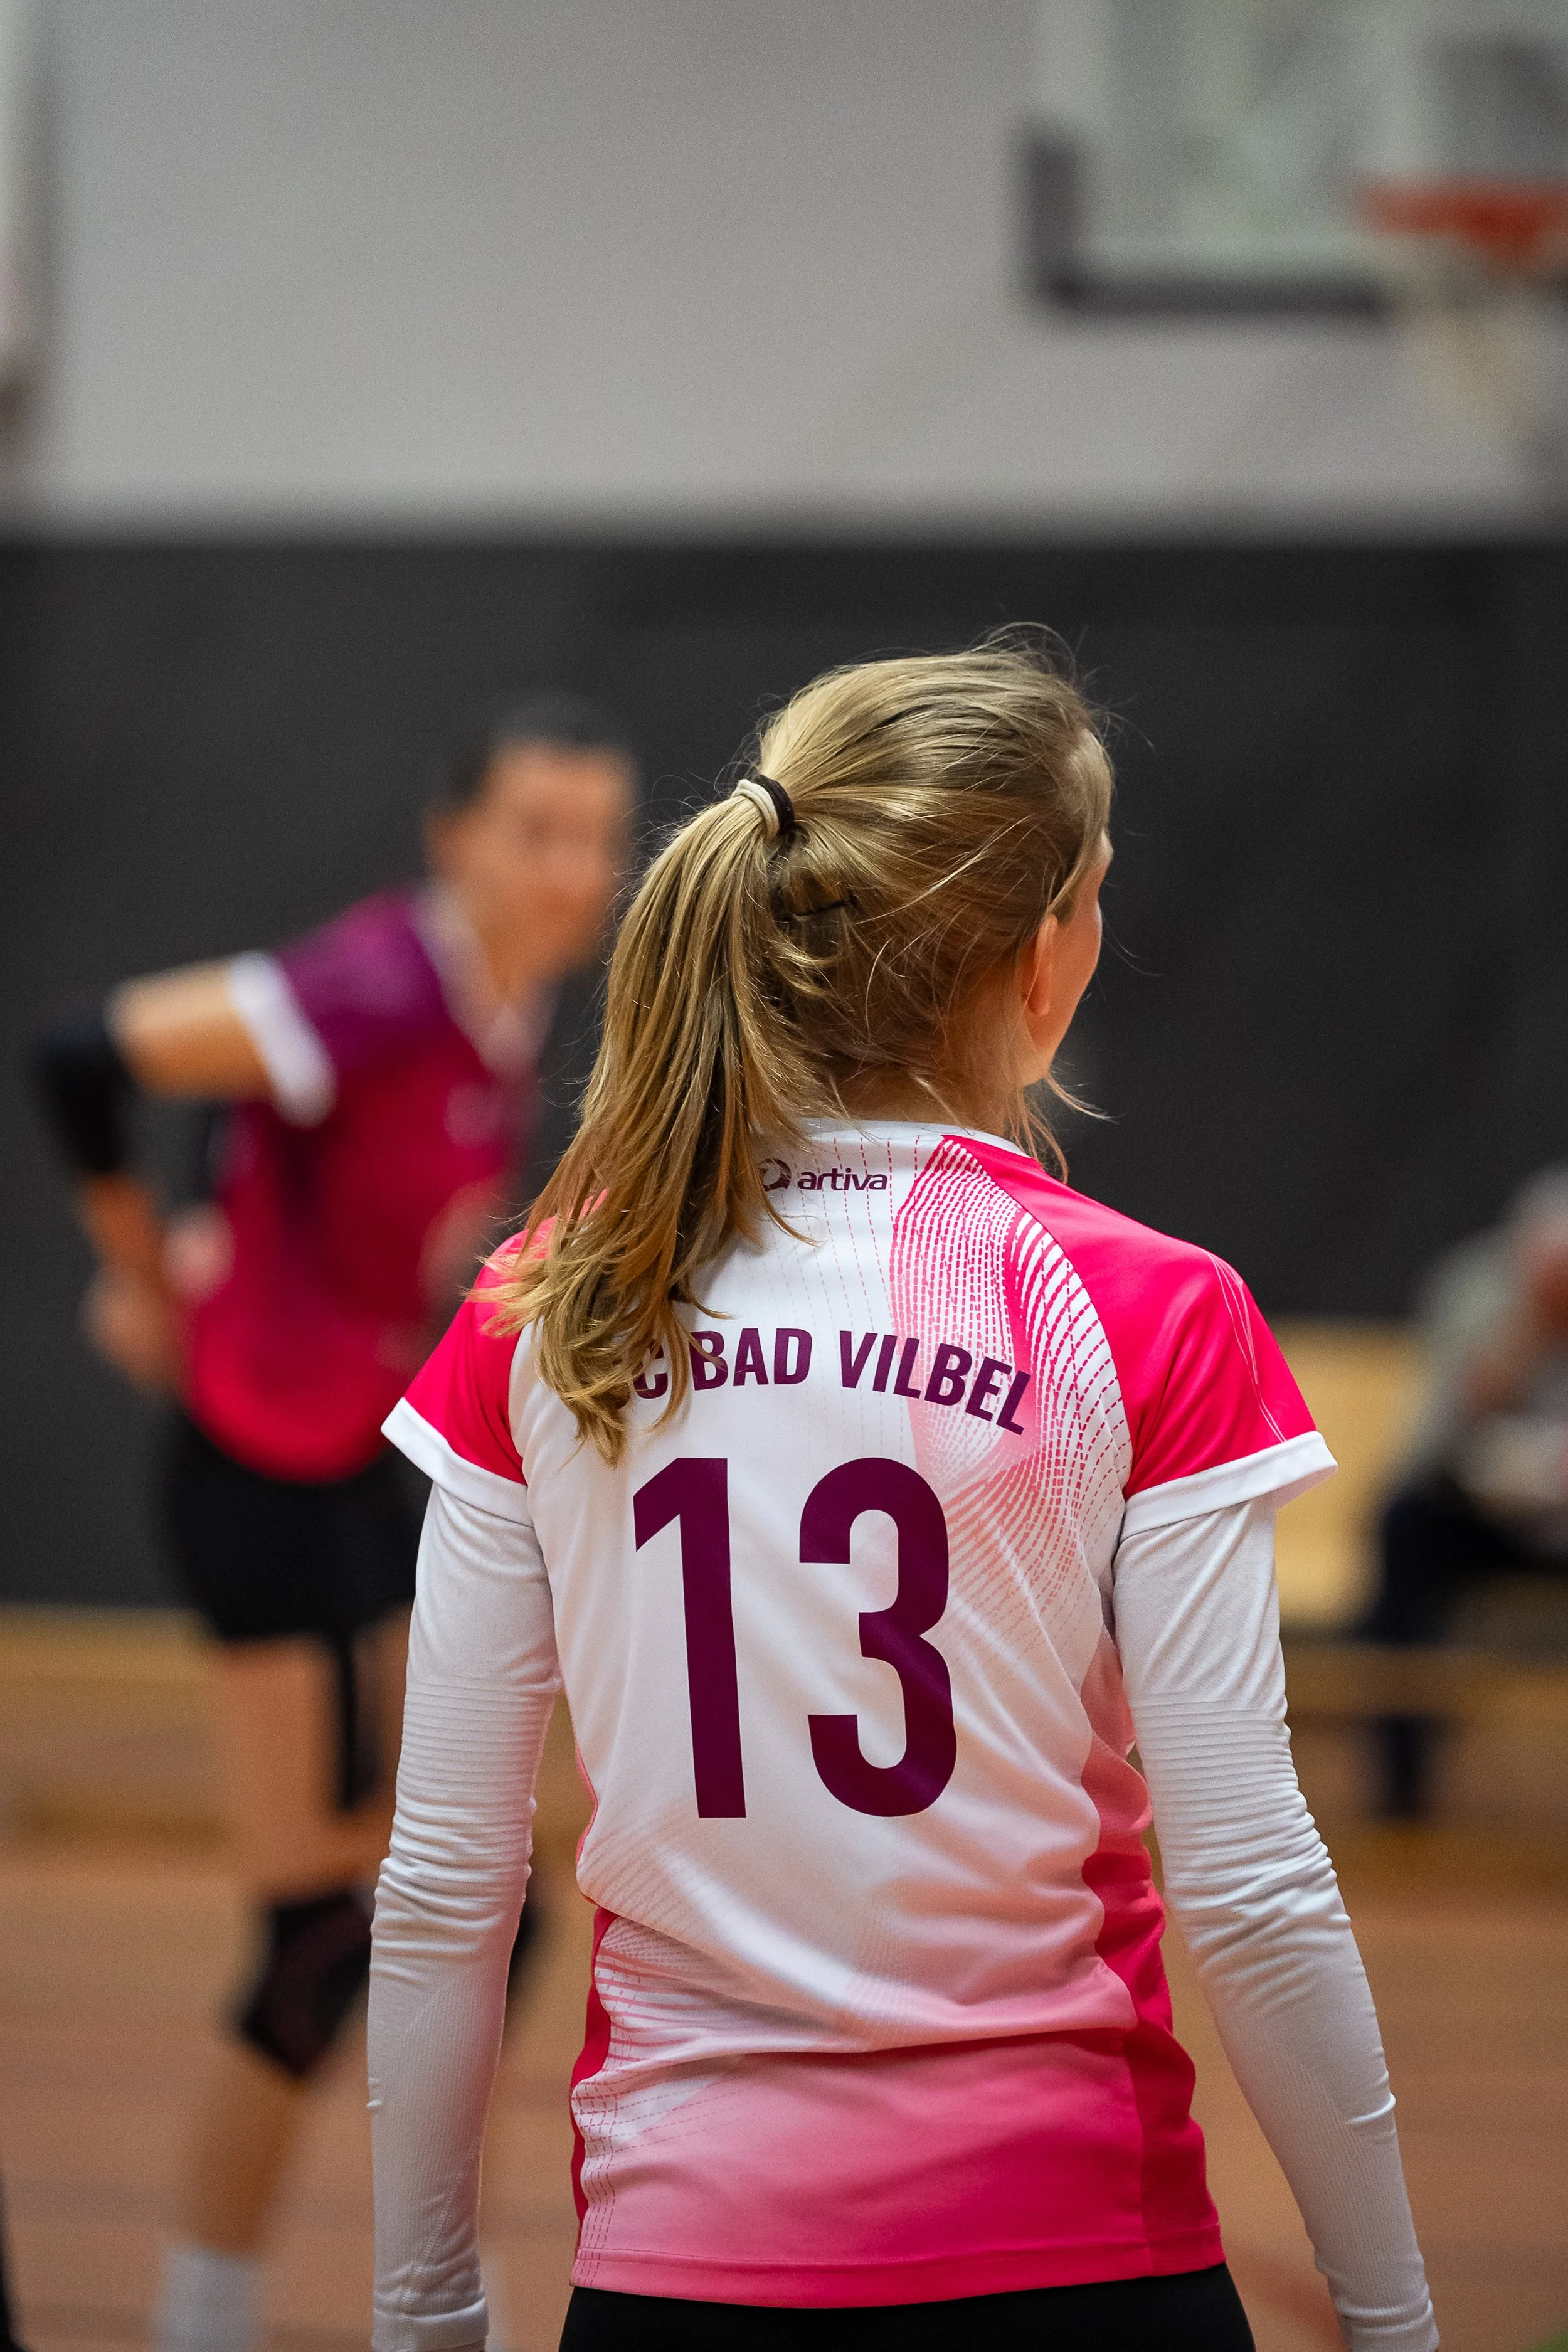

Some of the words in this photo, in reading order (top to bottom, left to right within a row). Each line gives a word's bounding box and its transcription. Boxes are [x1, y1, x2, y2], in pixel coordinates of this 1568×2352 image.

[797, 1168, 888, 1191] artiva
[690, 1328, 813, 1391] BAD
[839, 1330, 1032, 1436] VILBEL
[633, 1457, 957, 1818] 13
